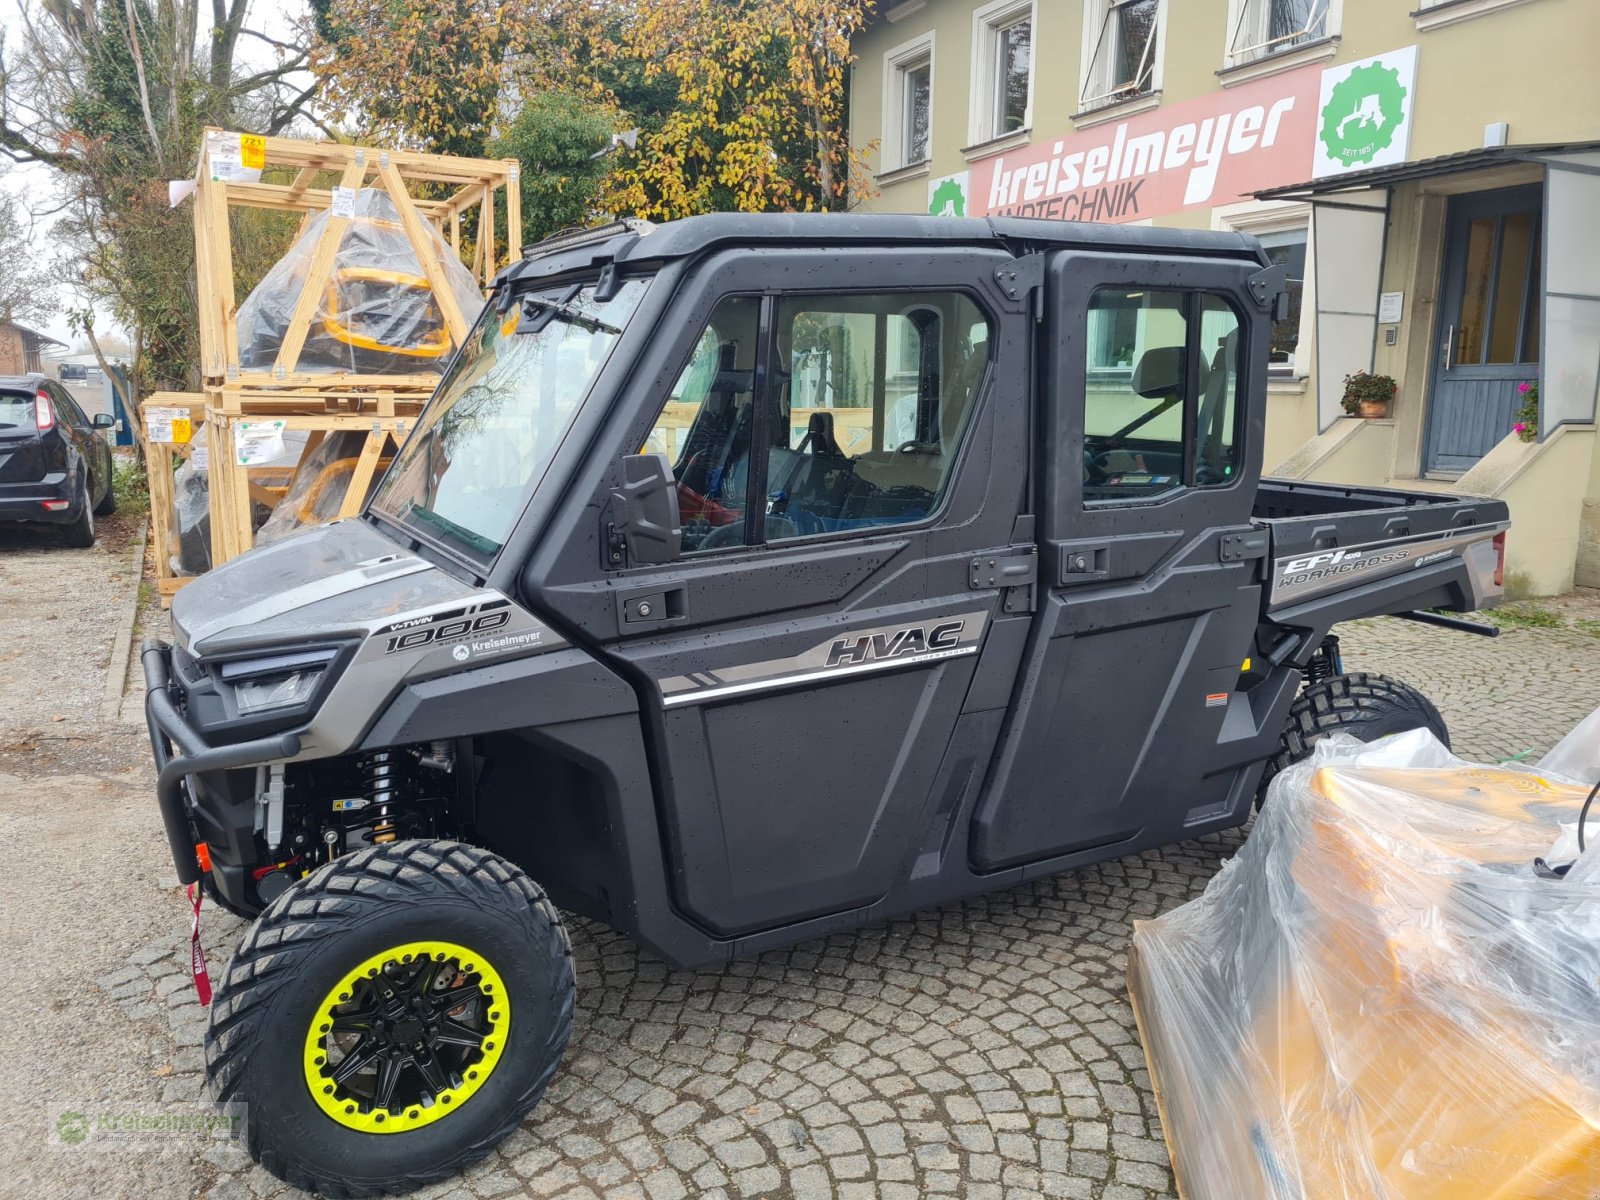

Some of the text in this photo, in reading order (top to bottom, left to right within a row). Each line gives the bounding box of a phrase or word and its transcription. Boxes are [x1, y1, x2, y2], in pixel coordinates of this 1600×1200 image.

[987, 96, 1296, 205] kreiselmeyer
[1277, 550, 1409, 589] WORKCROSS
[1283, 550, 1346, 575] EFI
[384, 610, 512, 655] 1000
[390, 616, 434, 631] V-TWIN
[472, 631, 541, 652] Kreiselmeyer
[823, 620, 966, 668] HVAC
